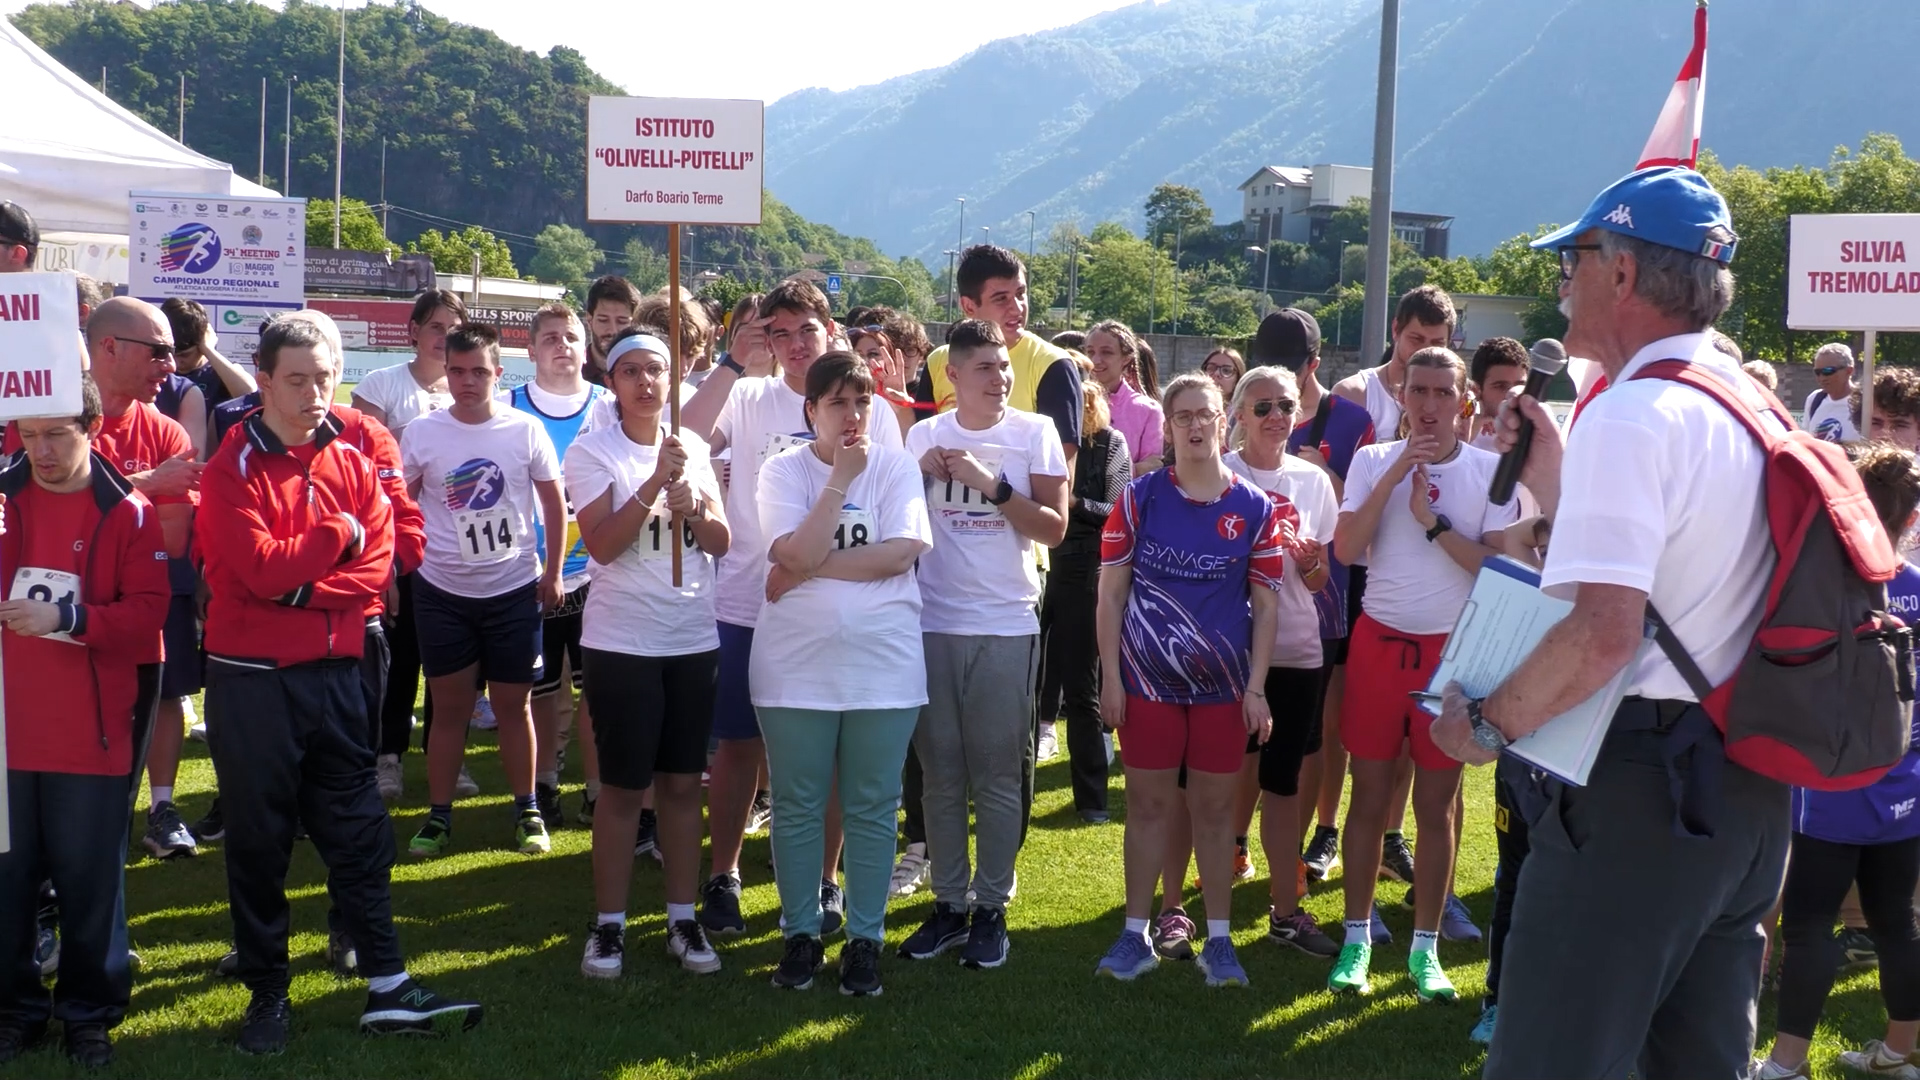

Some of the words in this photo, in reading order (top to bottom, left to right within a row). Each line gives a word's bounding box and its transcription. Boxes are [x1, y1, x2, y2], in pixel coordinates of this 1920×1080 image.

[635, 117, 715, 139] ISTITUTO
[625, 189, 653, 204] Darfo
[656, 190, 689, 205] Boario
[692, 191, 724, 205] Terme
[239, 248, 280, 259] MEETING
[1840, 240, 1906, 263] SILVIA
[244, 262, 275, 272] MAGGIO
[329, 257, 340, 266] di
[342, 258, 370, 269] prima
[324, 265, 337, 275] da
[153, 276, 220, 286] CAMPIONATO
[222, 279, 280, 289] REGIONALE
[202, 285, 231, 293] LEGGERA
[1807, 271, 1920, 294] TREMOLAD
[501, 310, 537, 322] SPOR
[972, 519, 1006, 528] MEETING
[465, 517, 513, 555] 114
[648, 515, 696, 551] 16
[1142, 539, 1230, 571] SYNAGE
[1165, 566, 1204, 579] BUILDING
